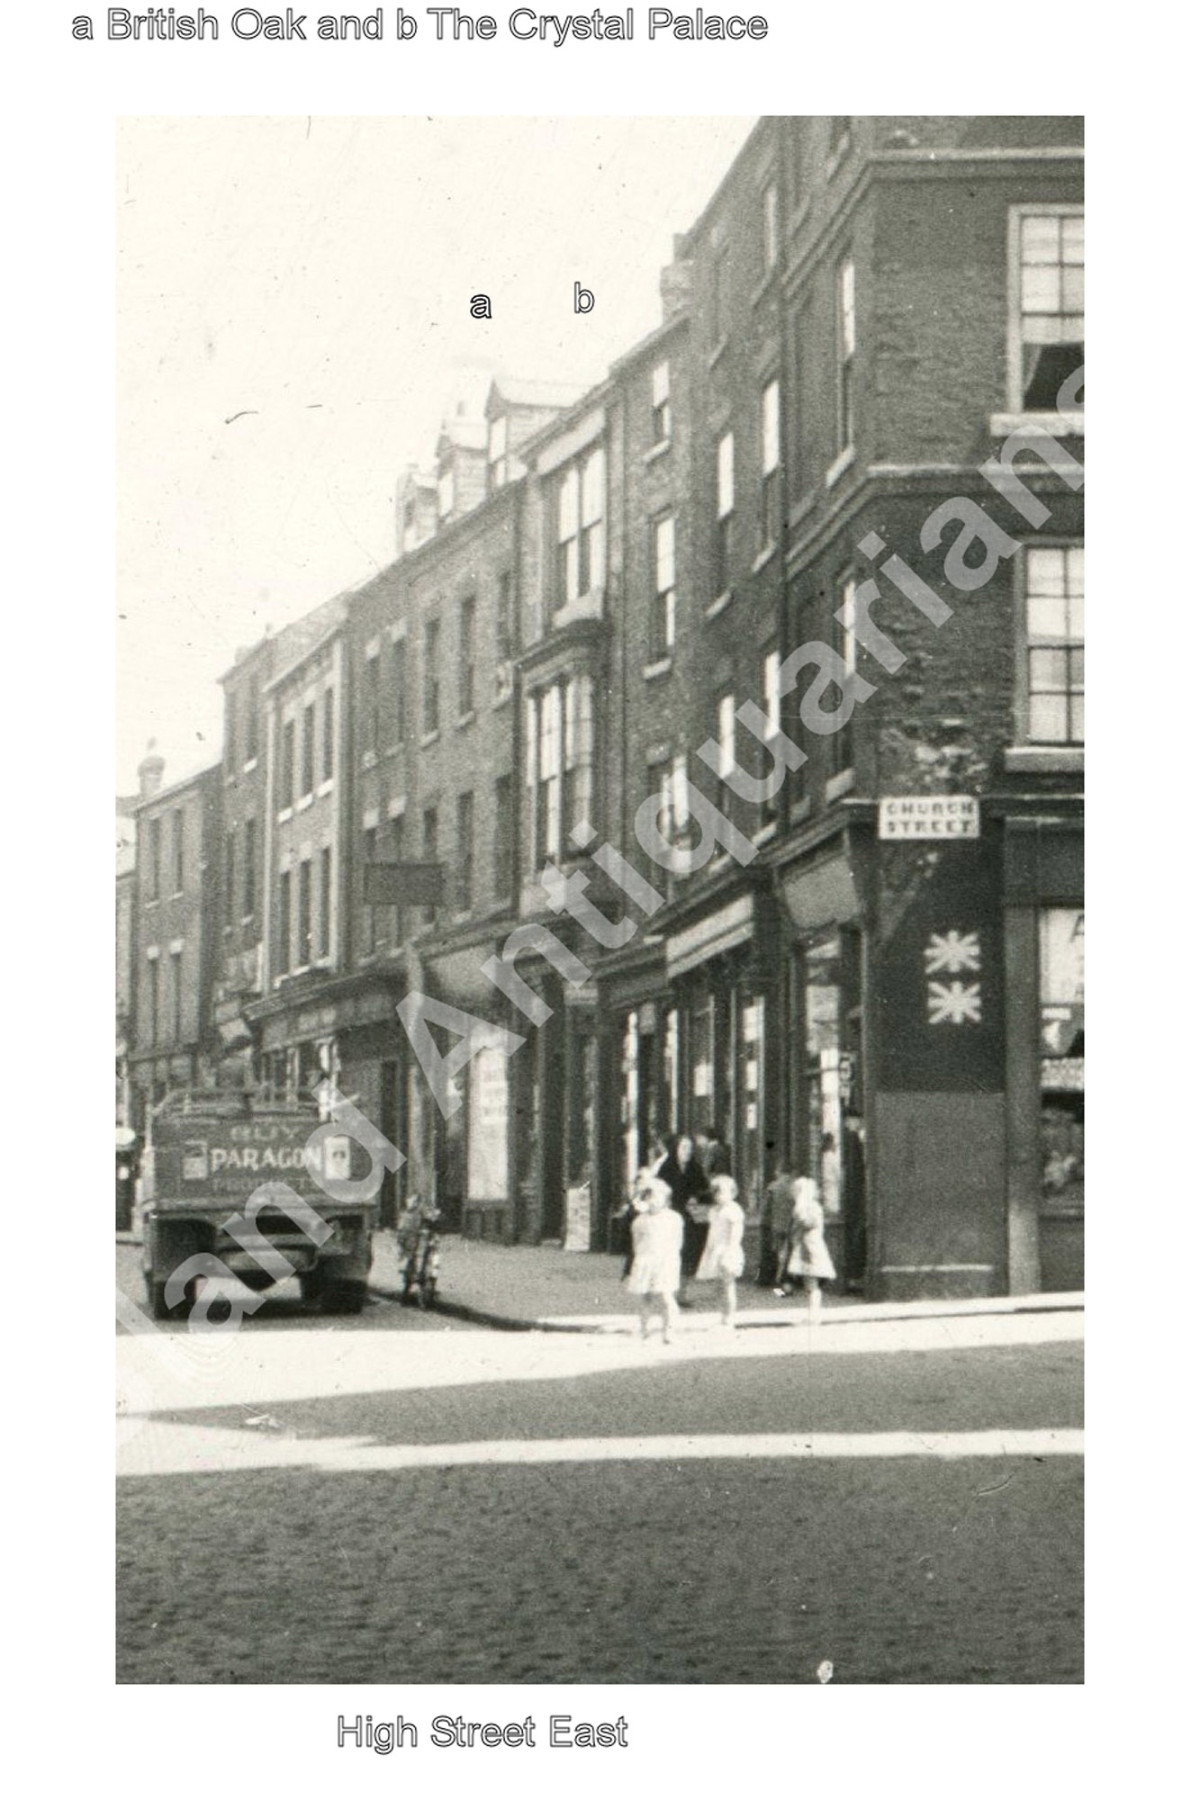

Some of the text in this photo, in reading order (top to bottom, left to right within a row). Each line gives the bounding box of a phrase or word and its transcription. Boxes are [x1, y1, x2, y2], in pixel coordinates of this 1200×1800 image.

[886, 801, 974, 814] CHURCH
[887, 819, 974, 834] STREET
[210, 1147, 323, 1172] PARAGON
